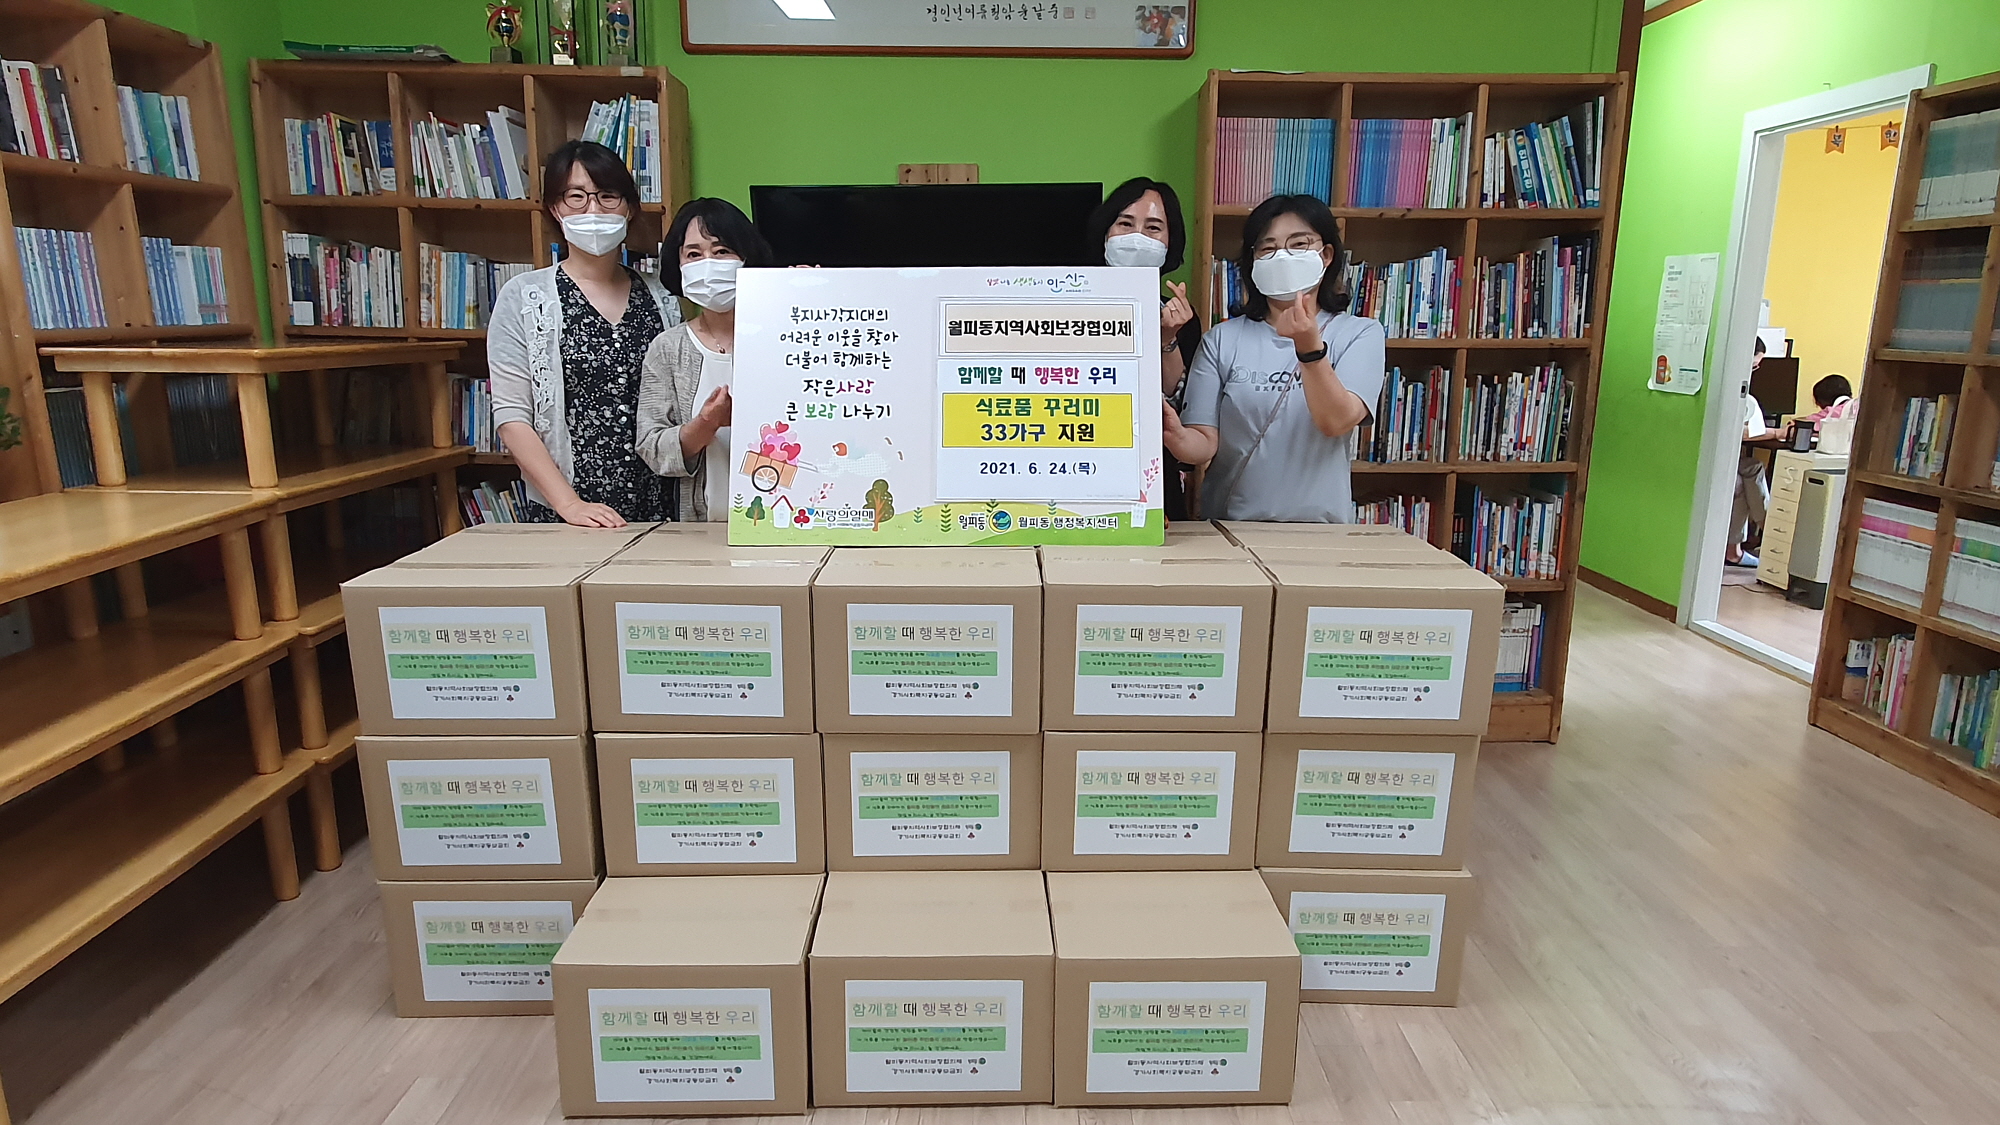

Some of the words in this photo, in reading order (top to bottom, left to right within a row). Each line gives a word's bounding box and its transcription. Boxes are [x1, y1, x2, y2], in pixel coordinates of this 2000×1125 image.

[790, 306, 888, 324] 복지사각지대의
[948, 319, 1132, 338] 월피동지역사회보장협의체
[780, 329, 822, 346] 어려운
[827, 329, 862, 347] 이웃을
[866, 328, 899, 346] 찾아
[786, 351, 827, 370] 더불어
[832, 351, 892, 370] 함께하는
[958, 366, 1003, 386] 함께할
[1011, 366, 1026, 386] 때
[1034, 366, 1080, 386] 행복한
[1088, 366, 1117, 386] 우리
[786, 402, 798, 421] 큰
[805, 403, 837, 419] 보람
[843, 404, 890, 420] 나누기
[976, 398, 1032, 418] 식료품
[1044, 398, 1100, 418] 꾸러미
[980, 423, 1046, 442] 33가구
[1058, 422, 1095, 442] 지원
[980, 462, 1021, 475] 2021.
[1028, 462, 1042, 475] 6.
[1049, 462, 1097, 475] 24.(목)
[958, 516, 985, 530] 월피동
[1018, 517, 1050, 528] 월피동
[1054, 517, 1118, 528] 행정복지센터
[435, 629, 450, 644] 때
[453, 629, 497, 644] 행복한
[501, 629, 530, 644] 우리
[674, 625, 689, 640] 때
[692, 625, 736, 641] 행복한
[740, 626, 768, 641] 우리
[900, 626, 915, 640] 때
[918, 626, 962, 640] 행복한
[966, 626, 995, 641] 우리
[1130, 627, 1145, 641] 때
[1147, 627, 1191, 642] 행복한
[1195, 627, 1223, 642] 우리
[1359, 629, 1374, 644] 때
[1376, 629, 1419, 644] 행복한
[1424, 629, 1452, 645] 우리
[684, 779, 699, 792] 때
[701, 779, 744, 792] 행복한
[749, 779, 776, 792] 우리
[906, 772, 921, 785] 때
[923, 772, 965, 785] 행복한
[969, 772, 996, 785] 우리
[1127, 771, 1141, 785] 때
[1143, 771, 1186, 785] 행복한
[1190, 772, 1217, 785] 우리
[1346, 770, 1360, 785] 때
[1363, 771, 1404, 786] 행복한
[1408, 772, 1436, 786] 우리
[447, 780, 462, 794] 때
[464, 780, 507, 794] 행복한
[511, 779, 539, 793] 우리
[1342, 912, 1356, 925] 때
[1359, 912, 1399, 925] 행복한
[1404, 912, 1430, 926] 우리
[903, 1002, 919, 1016] 때
[922, 1002, 969, 1016] 행복한
[973, 1002, 1003, 1016] 우리
[1147, 1003, 1163, 1018] 때
[1165, 1003, 1212, 1018] 행복한
[1216, 1003, 1246, 1018] 우리
[653, 1011, 670, 1025] 때
[672, 1011, 721, 1025] 행복한
[725, 1010, 756, 1025] 우리
